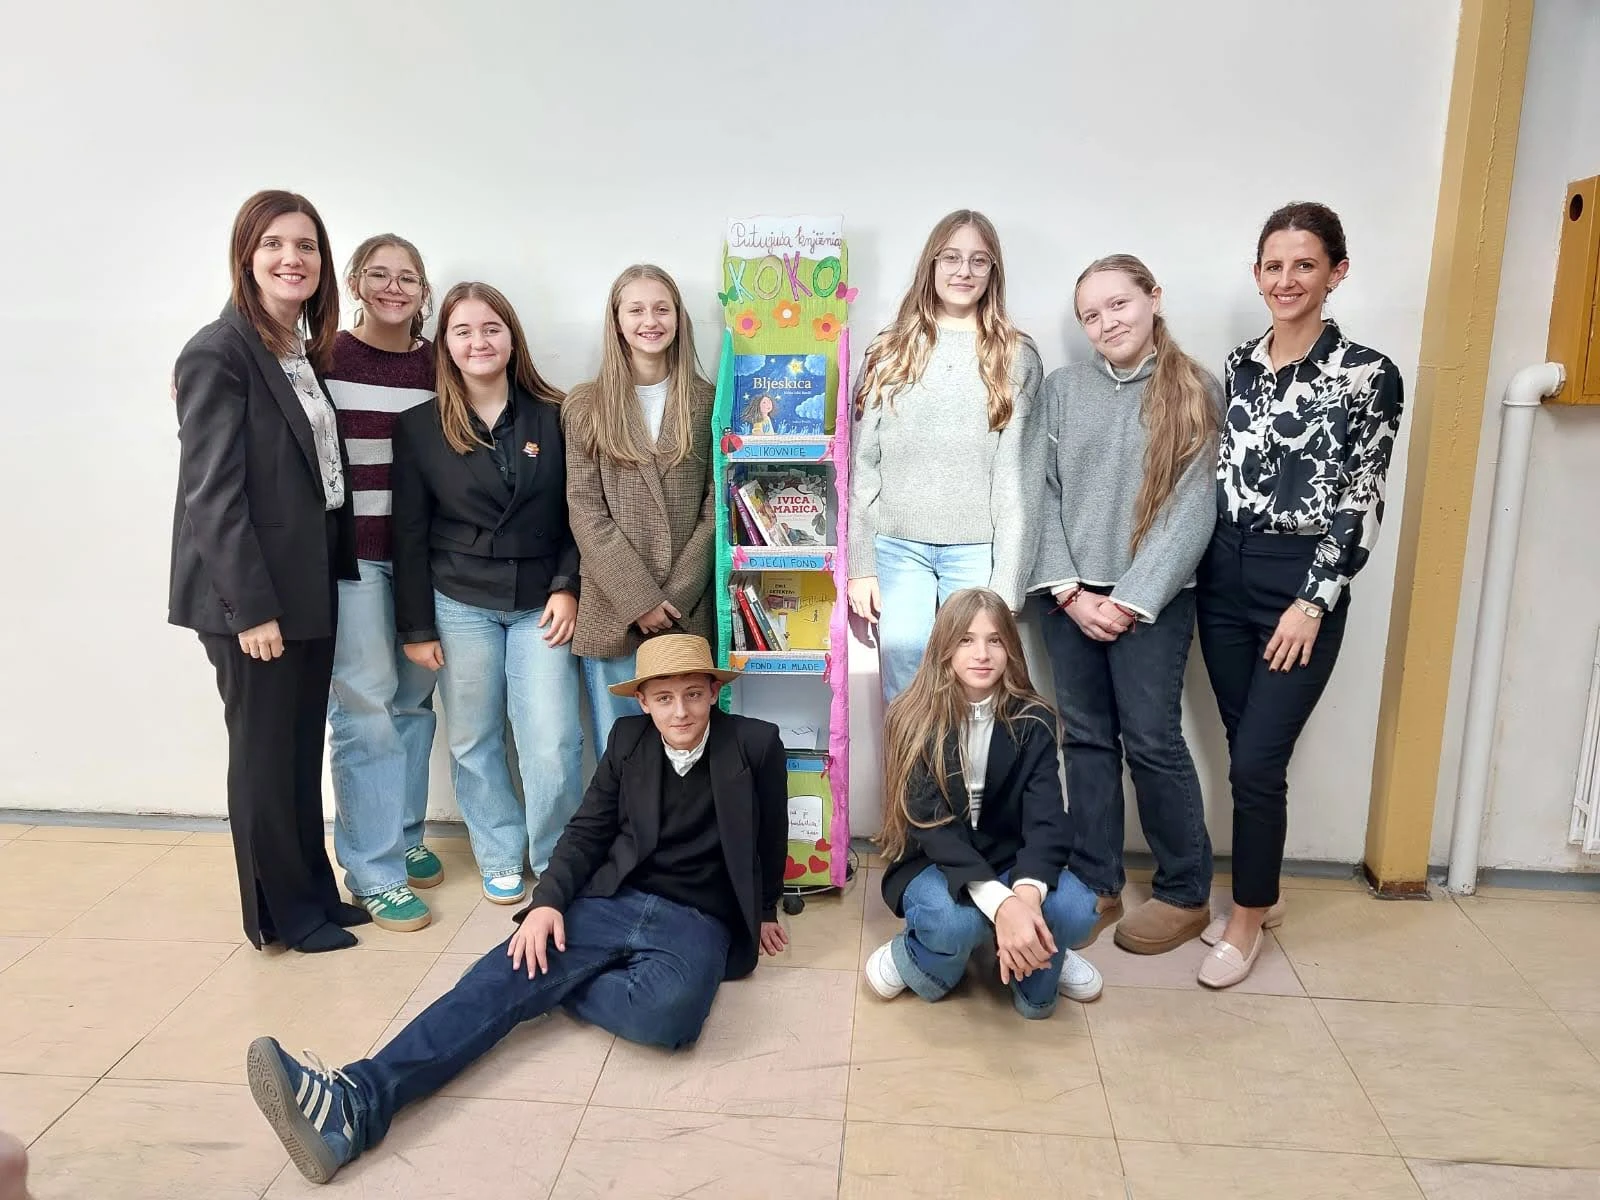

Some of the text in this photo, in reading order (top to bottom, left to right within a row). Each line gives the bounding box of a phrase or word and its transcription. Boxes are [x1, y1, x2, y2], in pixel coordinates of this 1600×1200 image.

[753, 377, 812, 393] Bljeskica
[744, 446, 806, 457] SLIKOVNICE
[777, 496, 810, 504] IVICA
[773, 505, 819, 513] MARICA
[791, 558, 817, 568] FOND
[750, 662, 772, 670] FOND
[791, 663, 820, 671] MLADE
